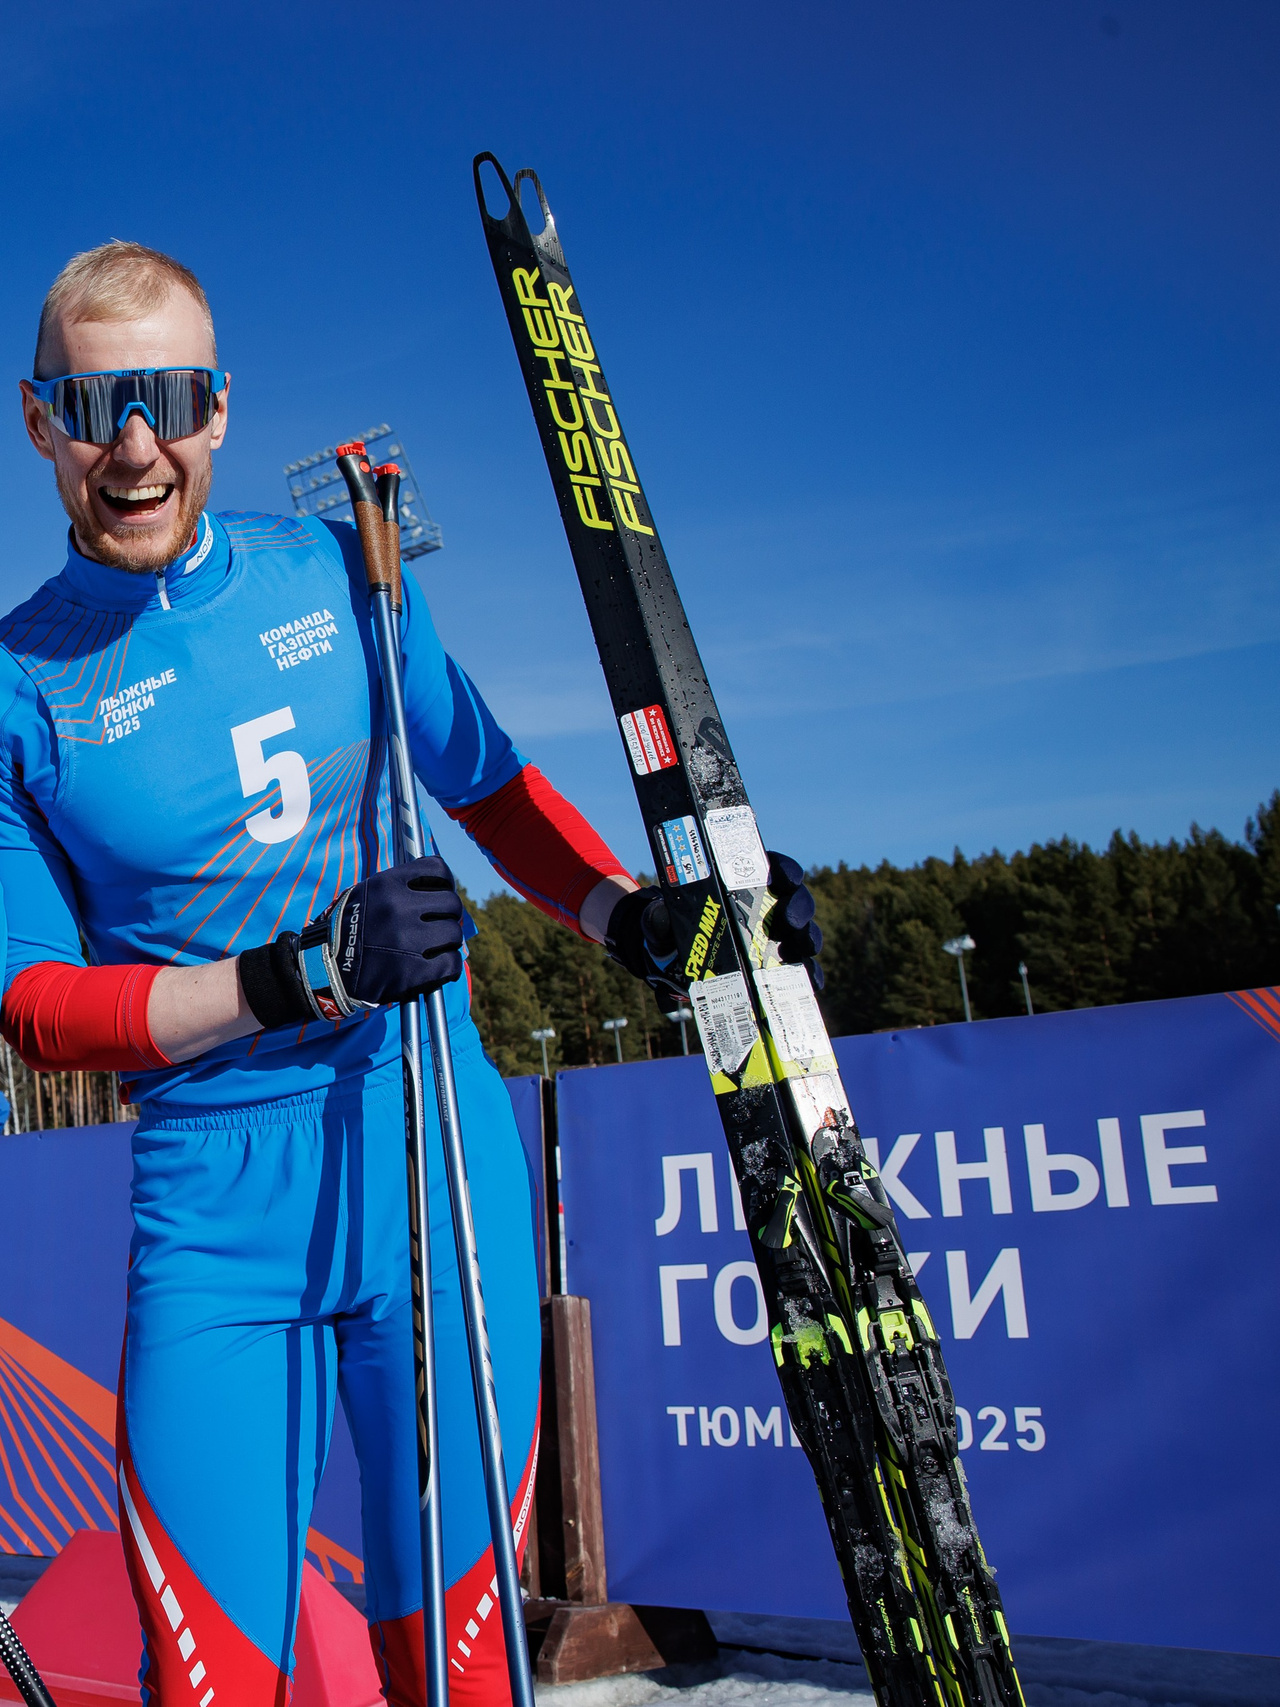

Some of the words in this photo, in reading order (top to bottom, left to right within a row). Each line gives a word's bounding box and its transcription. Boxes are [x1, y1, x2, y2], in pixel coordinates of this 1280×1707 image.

[511, 266, 614, 531] FISCHER
[546, 281, 655, 536] FISCHER
[258, 609, 335, 647] КОМАНДА
[267, 622, 339, 659] ГАЗПРОМ
[276, 639, 333, 672] НЕФТИ
[99, 668, 177, 716] ЛЫЖНЫЕ
[103, 693, 156, 728] ГОНКИ
[106, 716, 141, 744] 2025
[230, 705, 312, 845] 5
[342, 902, 361, 972] NORDSKI
[684, 933, 709, 982] SPEED
[698, 894, 721, 939] MAX
[708, 941, 720, 969] SKATE
[716, 917, 728, 941] PLUS
[655, 1109, 1219, 1237] ЛЖНЫЕ
[658, 1246, 1030, 1348] ГОИ
[667, 1406, 803, 1447] ТЮМ
[955, 1406, 1047, 1452] 025
